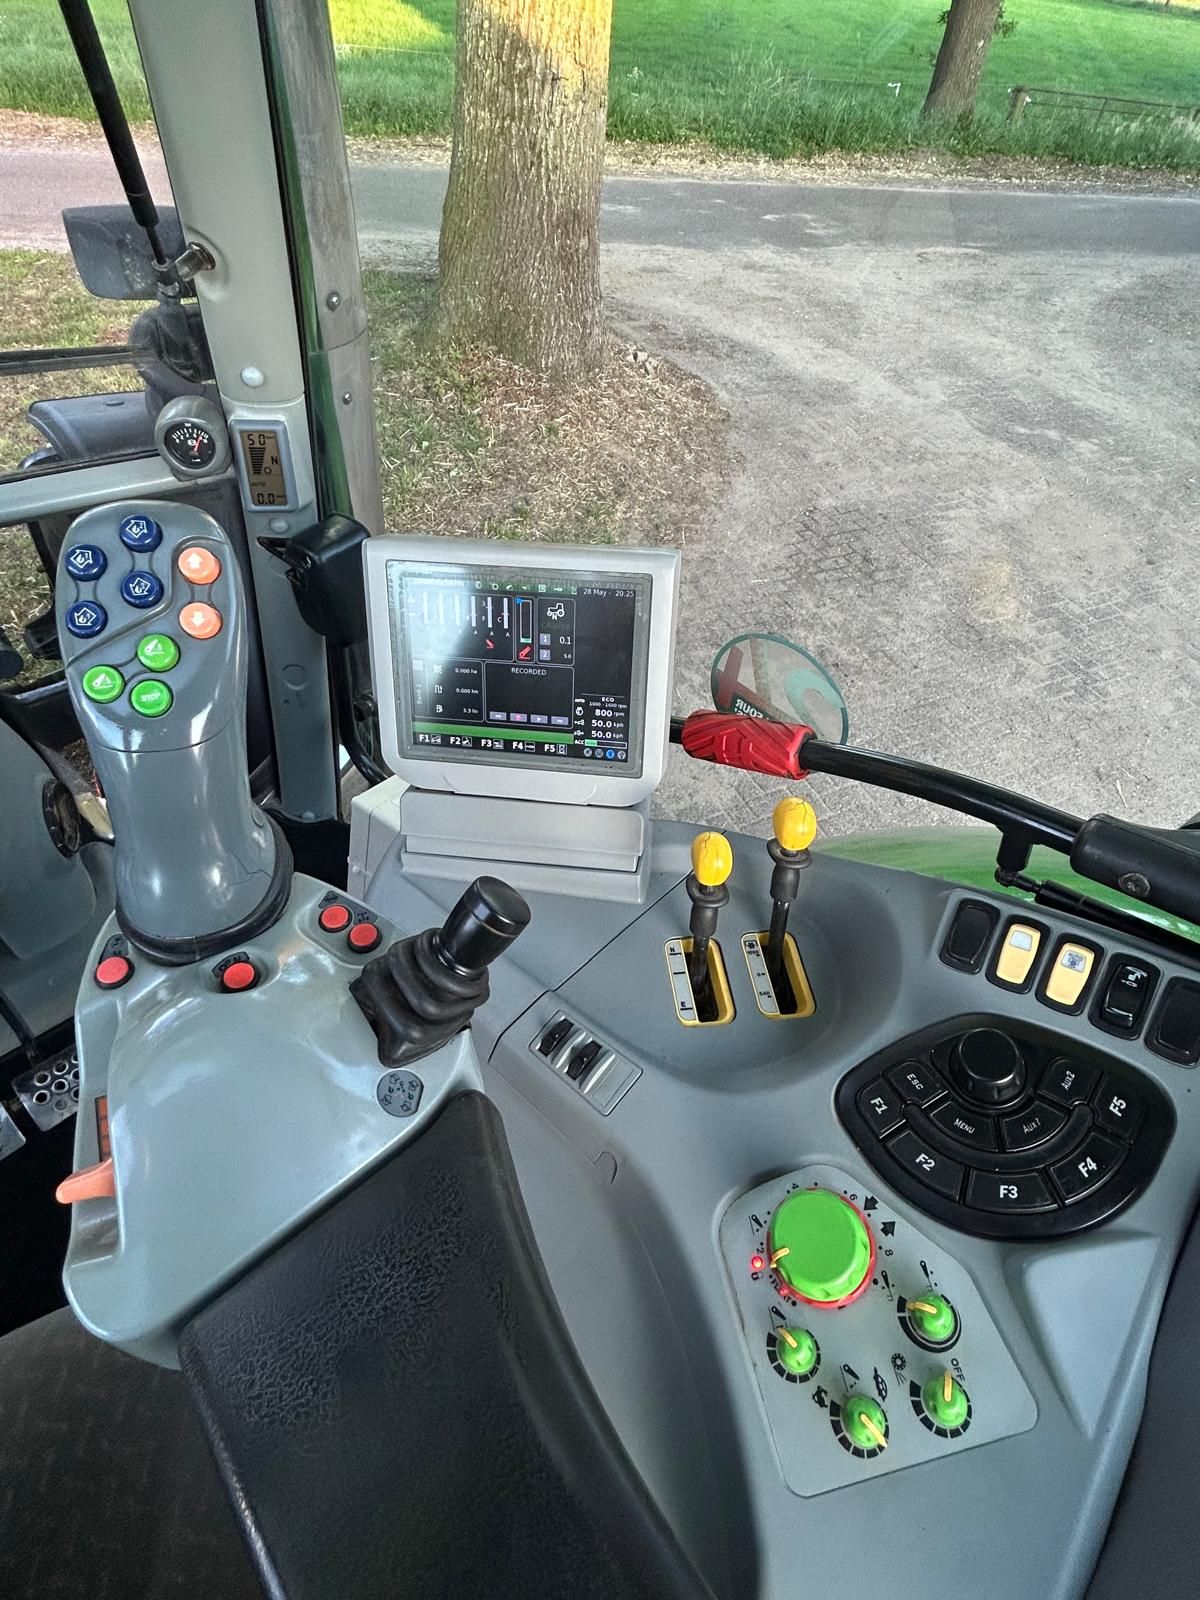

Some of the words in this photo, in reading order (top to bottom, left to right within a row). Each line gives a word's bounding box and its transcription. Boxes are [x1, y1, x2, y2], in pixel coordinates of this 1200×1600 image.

[271, 456, 278, 465] N
[593, 589, 607, 597] May
[559, 636, 571, 645] 0.1
[511, 667, 547, 676] RECORDED
[595, 708, 613, 717] 800
[591, 719, 612, 728] 50.0
[419, 734, 430, 743] F1
[591, 730, 612, 739] 50.0
[450, 737, 461, 745] F2
[481, 739, 492, 748] F3
[512, 742, 524, 750] F4
[544, 744, 556, 753] F5
[906, 1073, 924, 1090] ESC
[870, 1097, 888, 1114] F1
[1109, 1096, 1127, 1117] F5
[953, 1118, 976, 1135] MENU
[915, 1153, 935, 1171] F2
[1078, 1156, 1098, 1178] F4
[791, 1182, 799, 1190] 4
[999, 1185, 1018, 1199] F3
[849, 1193, 858, 1201] 6
[885, 1248, 894, 1257] 8
[950, 1358, 966, 1381] OFF
